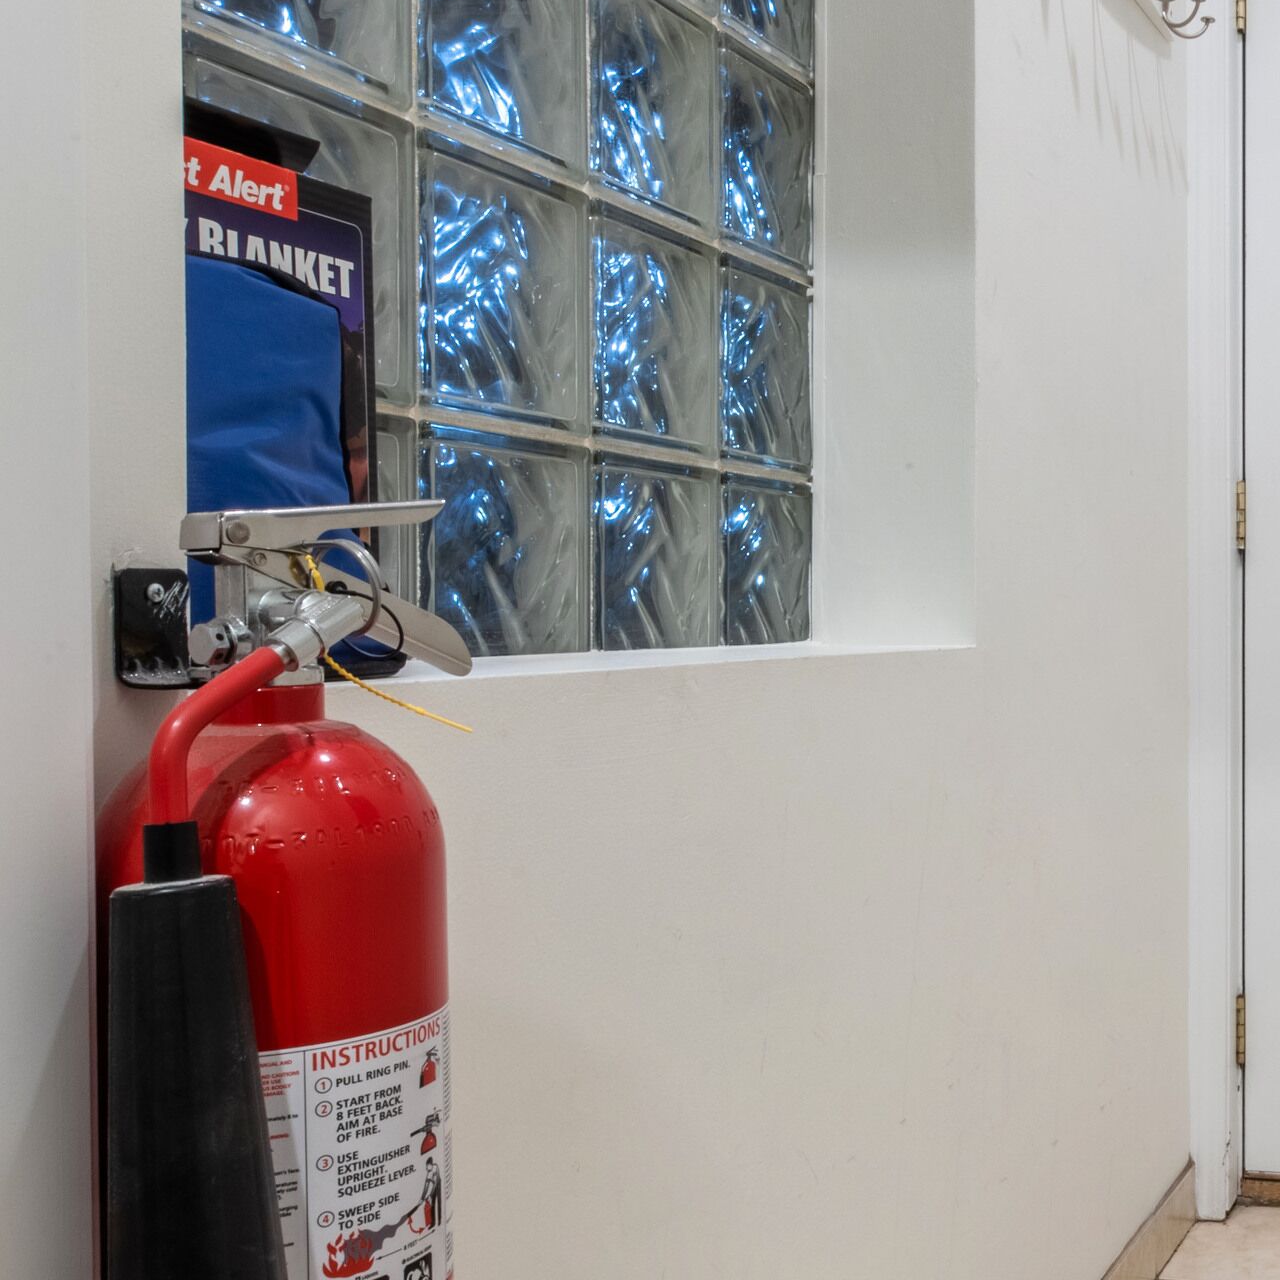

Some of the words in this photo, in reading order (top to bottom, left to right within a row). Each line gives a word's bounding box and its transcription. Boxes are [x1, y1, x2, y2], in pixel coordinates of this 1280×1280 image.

[208, 164, 284, 211] Alert
[311, 1017, 441, 1072] INSTRUCTIONS
[336, 1073, 362, 1088] PULL
[366, 1066, 391, 1081] RING
[394, 1060, 411, 1073] PIN.
[336, 1093, 371, 1111] START
[374, 1084, 402, 1101] FROM
[336, 1111, 343, 1121] 8
[347, 1104, 372, 1119] FEET
[376, 1095, 403, 1111] BACK.
[336, 1120, 359, 1133] AIM
[362, 1114, 378, 1127] AT
[380, 1105, 403, 1121] BASE
[336, 1131, 352, 1143] OF
[355, 1125, 381, 1139] FIRE.
[337, 1150, 359, 1164] USE
[337, 1144, 411, 1176] EXTINGUISHER
[337, 1165, 388, 1187] UPRIGHT.
[337, 1176, 386, 1199] SQUEEZE
[388, 1164, 416, 1182] LEVER.
[338, 1201, 376, 1221] SWEEP
[378, 1192, 400, 1208] SIDE
[338, 1220, 353, 1231] TO
[357, 1210, 381, 1226] SIDE
